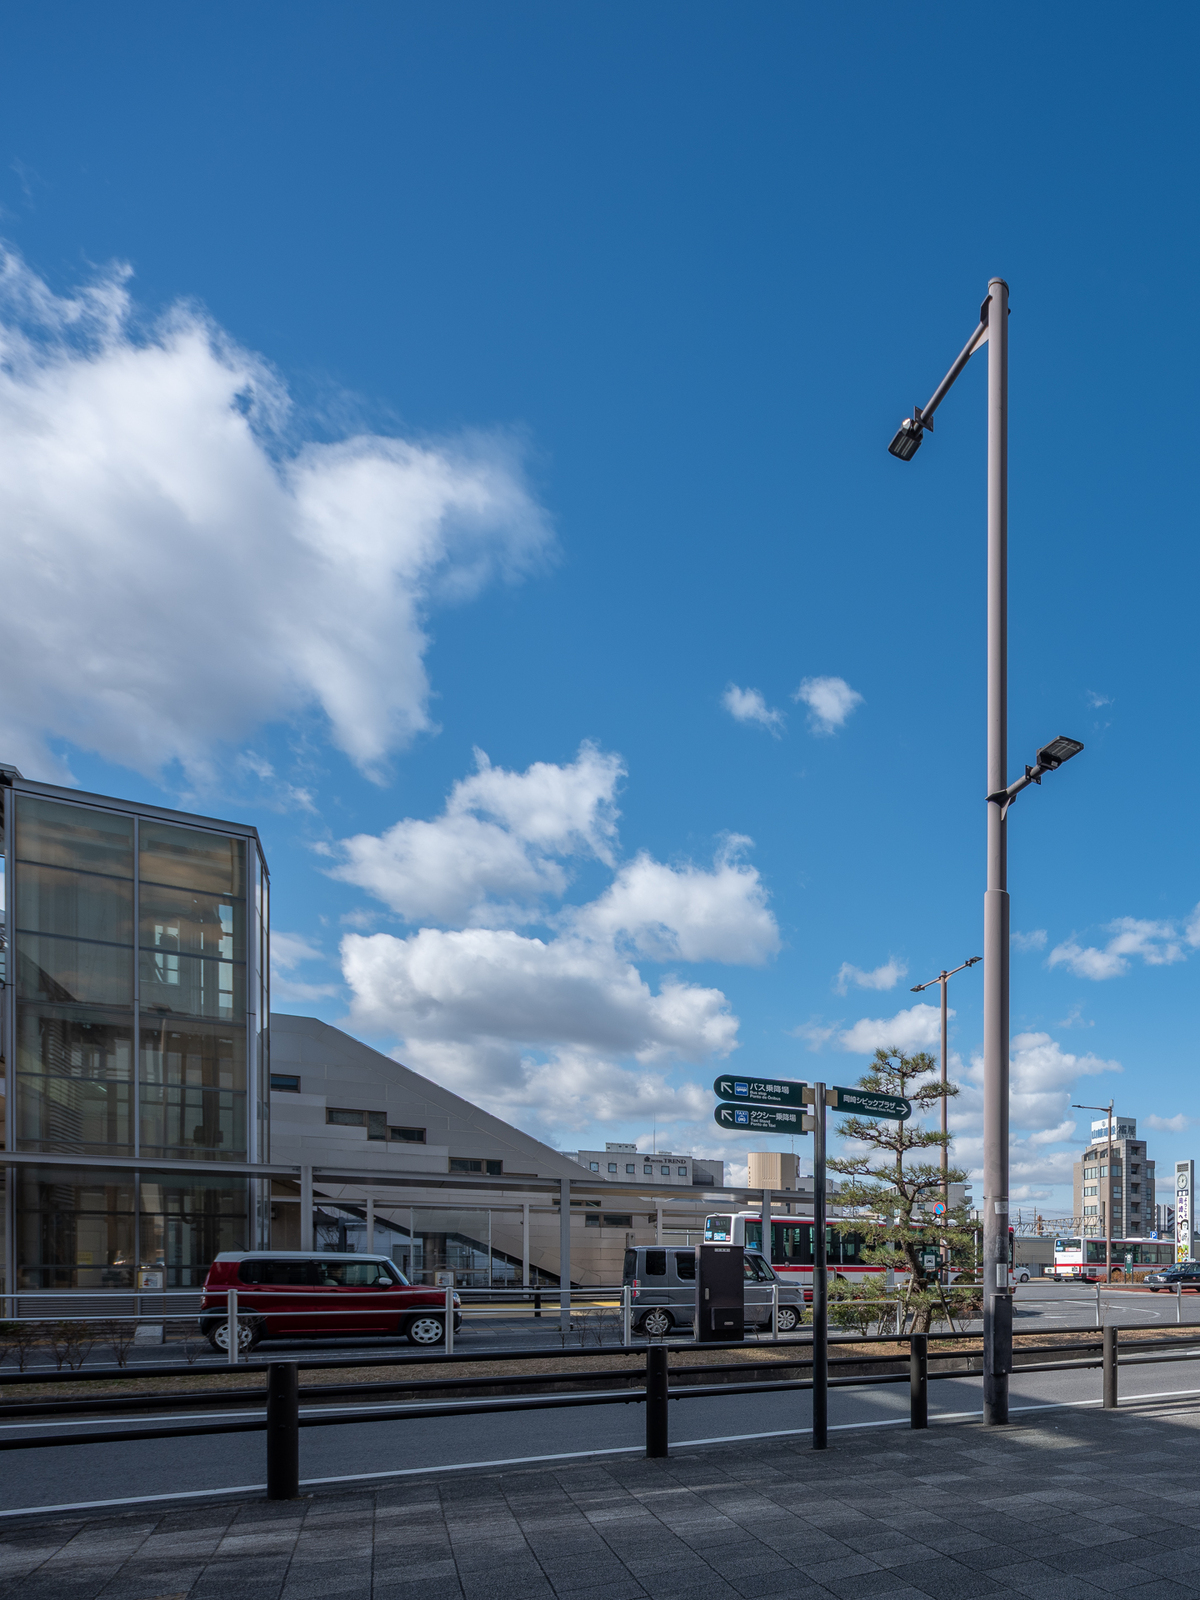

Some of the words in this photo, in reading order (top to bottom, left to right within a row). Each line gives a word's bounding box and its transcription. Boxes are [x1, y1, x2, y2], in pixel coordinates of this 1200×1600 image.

[750, 1083, 789, 1094] バス乗降場
[843, 1094, 896, 1110] 岡崎シビックプラザ
[750, 1111, 797, 1122] タクシー乗降場
